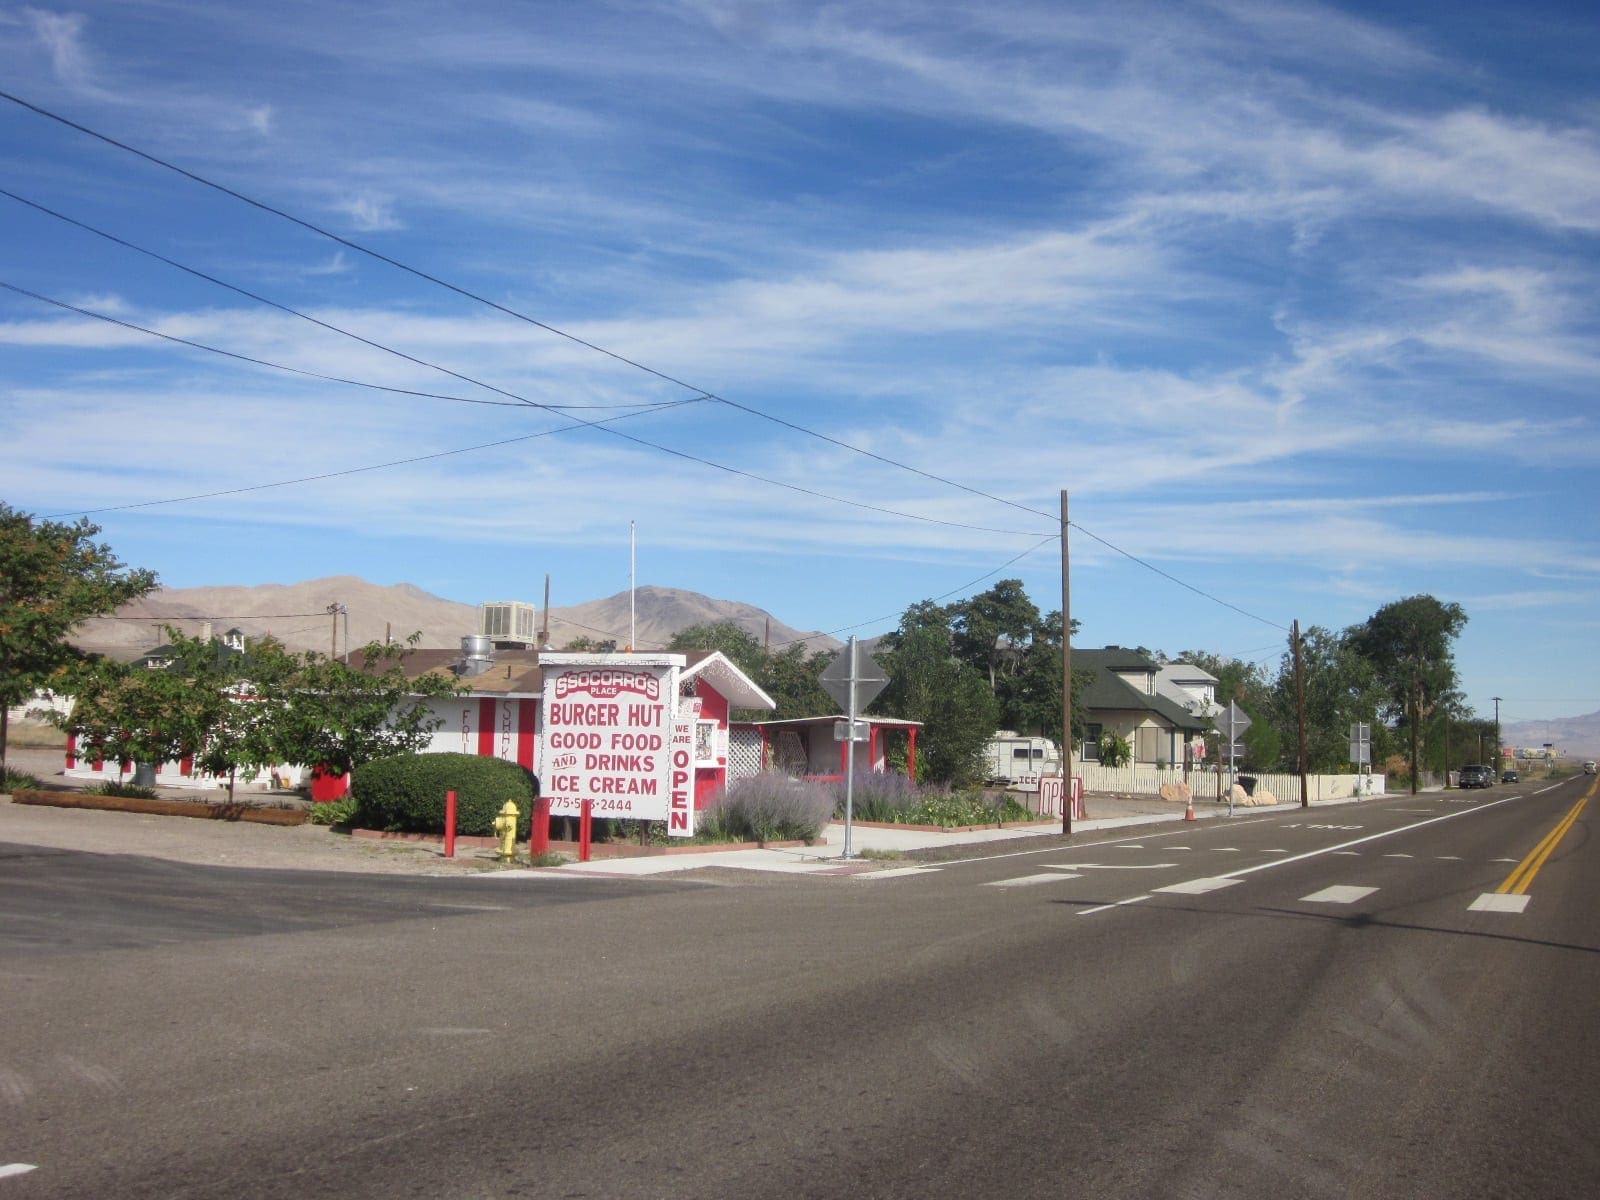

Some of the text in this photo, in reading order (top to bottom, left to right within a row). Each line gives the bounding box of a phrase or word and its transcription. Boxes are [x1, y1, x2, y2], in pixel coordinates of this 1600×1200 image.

[591, 687, 617, 695] PLACE
[550, 703, 619, 727] BURGER
[628, 704, 664, 727] HUT
[675, 724, 689, 733] WE
[550, 732, 662, 751] GOOD FOOD
[672, 735, 691, 744] ARE
[552, 754, 655, 772] AND DRINKS
[551, 775, 657, 796] ICE CREAM
[1019, 776, 1037, 785] ICE
[671, 750, 689, 830] OPEN
